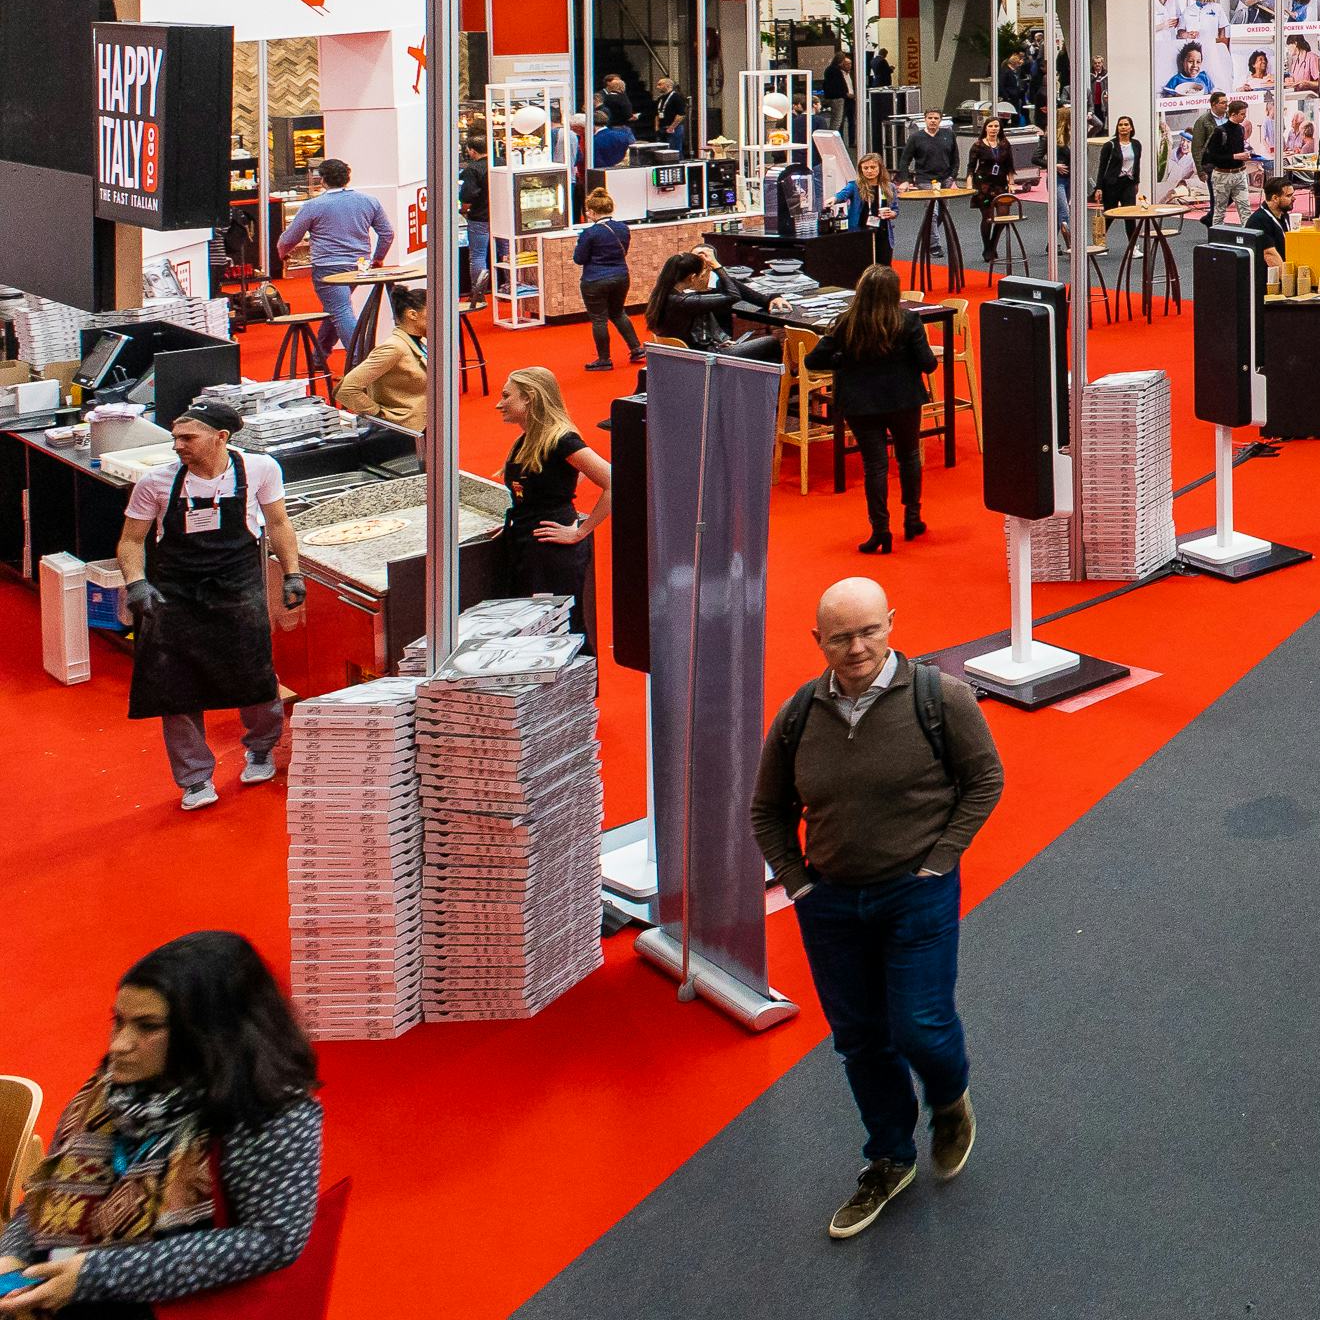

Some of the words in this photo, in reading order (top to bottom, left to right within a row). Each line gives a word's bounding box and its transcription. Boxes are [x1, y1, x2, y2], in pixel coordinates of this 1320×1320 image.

[98, 43, 164, 117] HAPPY
[98, 116, 145, 190] ITALY
[100, 187, 111, 203] THE
[113, 190, 129, 206] FAST
[131, 193, 159, 212] ITALIAN
